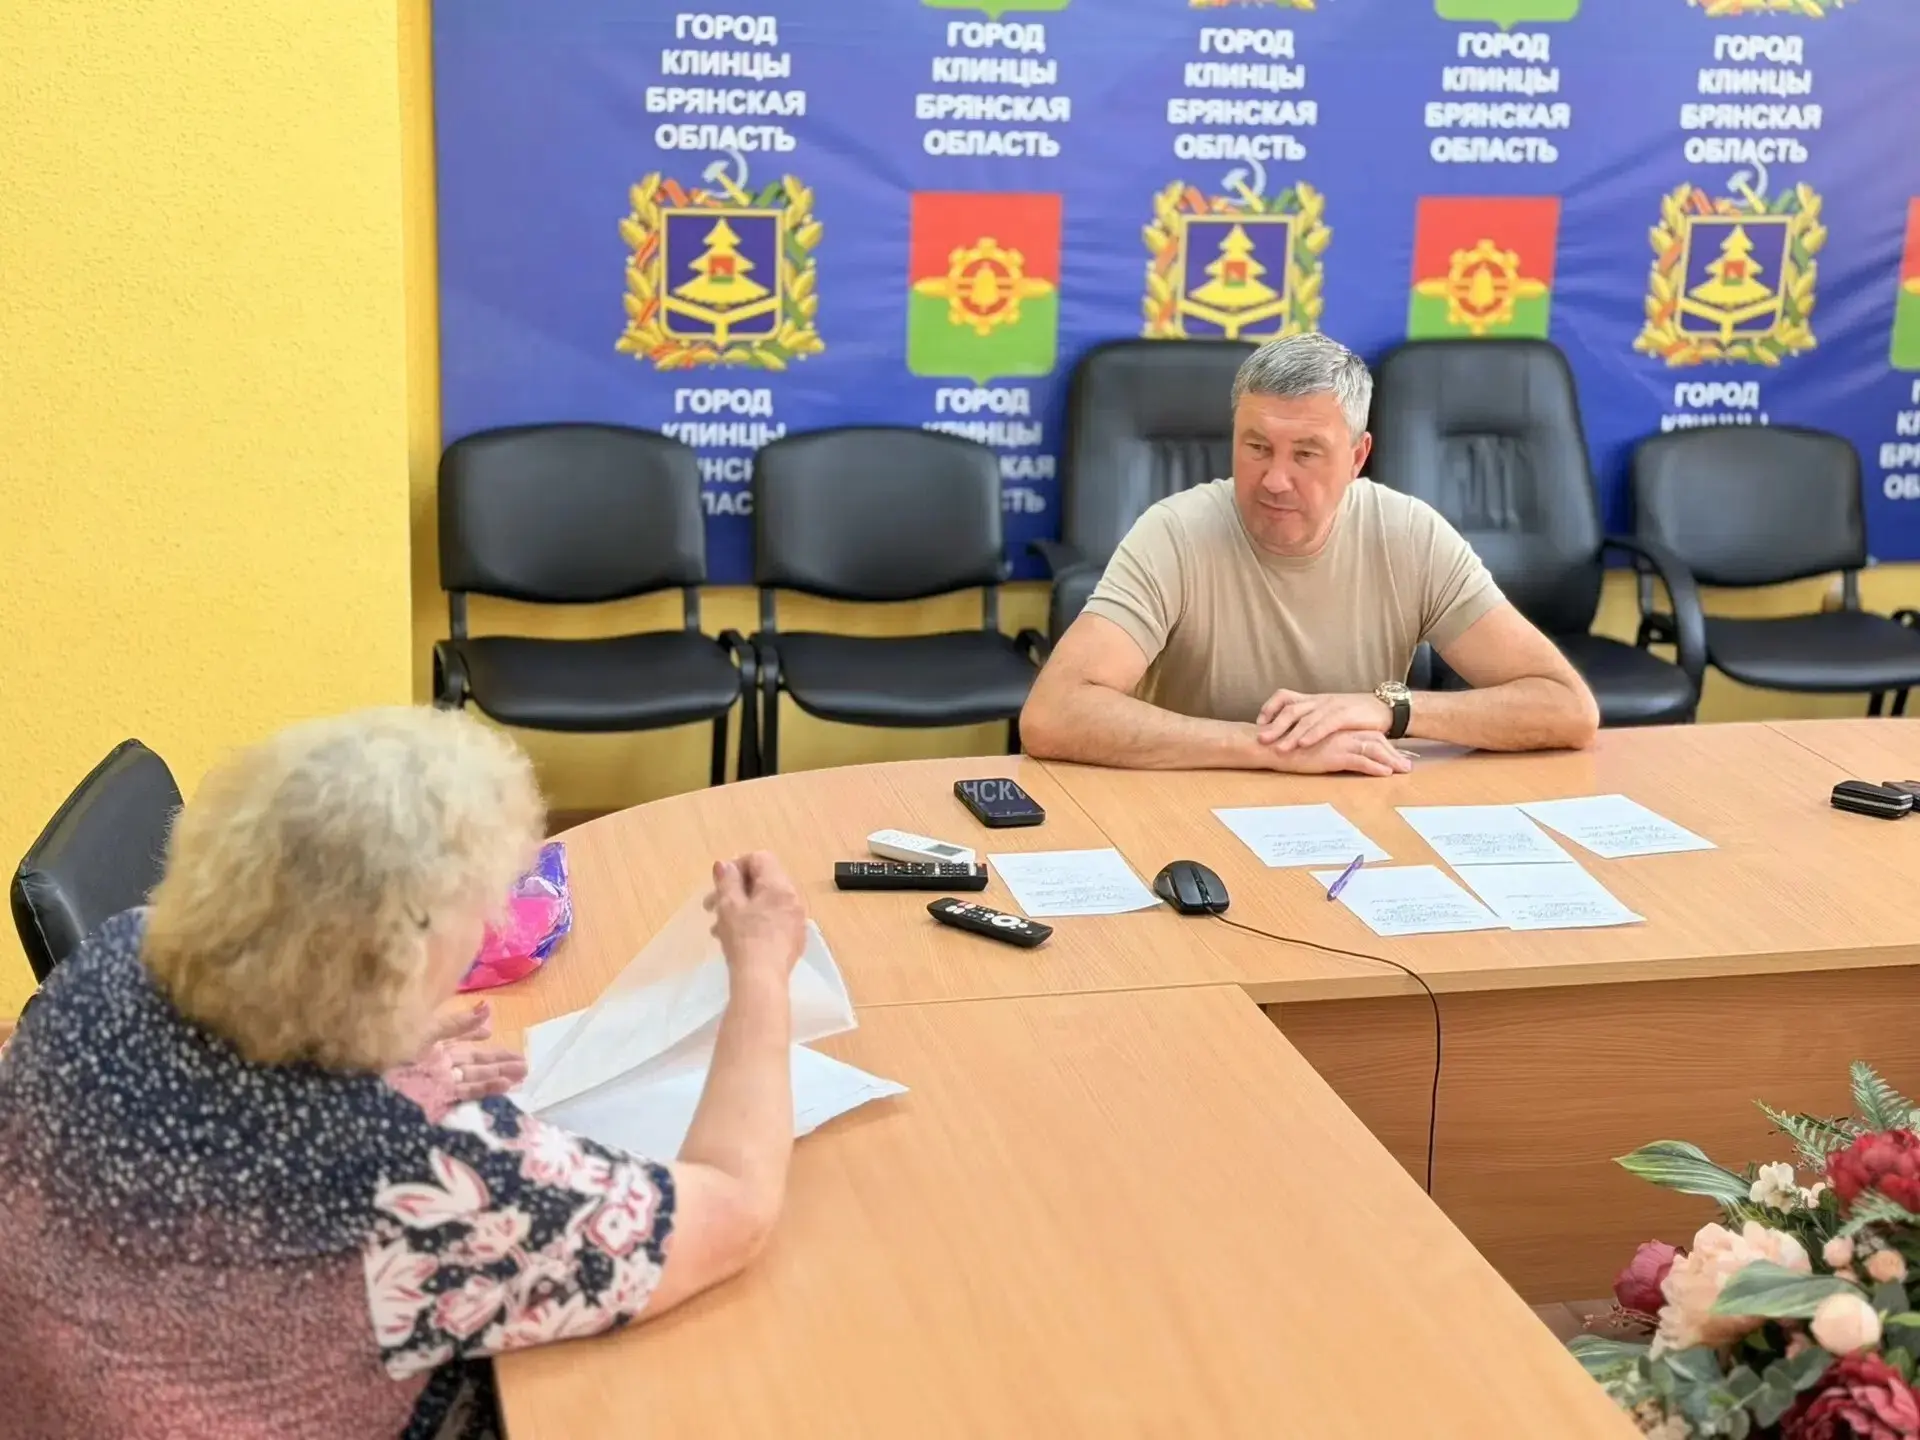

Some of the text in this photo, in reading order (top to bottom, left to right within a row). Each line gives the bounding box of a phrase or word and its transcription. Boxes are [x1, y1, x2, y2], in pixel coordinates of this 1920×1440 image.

[675, 13, 778, 46] ГОРОД
[947, 22, 1046, 53] ГОРОД
[1199, 27, 1295, 59] ГОРОД
[1457, 33, 1550, 63] ГОРОД
[1714, 34, 1804, 65] ГОРОД
[661, 49, 791, 81] КЛИНЦЫ
[932, 57, 1057, 87] КЛИНЦЫ
[1184, 62, 1305, 93] КЛИНЦЫ
[1442, 66, 1560, 96] КЛИНЦЫ
[1697, 68, 1812, 98] КЛИНЦЫ
[645, 86, 806, 116] БРЯНСКАЯ
[915, 94, 1071, 122] БРЯНСКАЯ
[1167, 98, 1318, 126] БРЯНСКАЯ
[1424, 102, 1571, 129] БРЯНСКАЯ
[1680, 103, 1823, 130] БРЯНСКАЯ
[654, 123, 797, 152] ОБЛАСТЬ
[923, 129, 1061, 157] ОБЛАСТЬ
[1173, 134, 1306, 161] ОБЛАСТЬ
[1430, 137, 1559, 163] ОБЛАСТЬ
[1683, 137, 1808, 163] ОБЛАСТЬ
[674, 388, 774, 418] ГОРОД
[935, 387, 1030, 417] ГОРОД
[1674, 381, 1760, 410] ГОРОД
